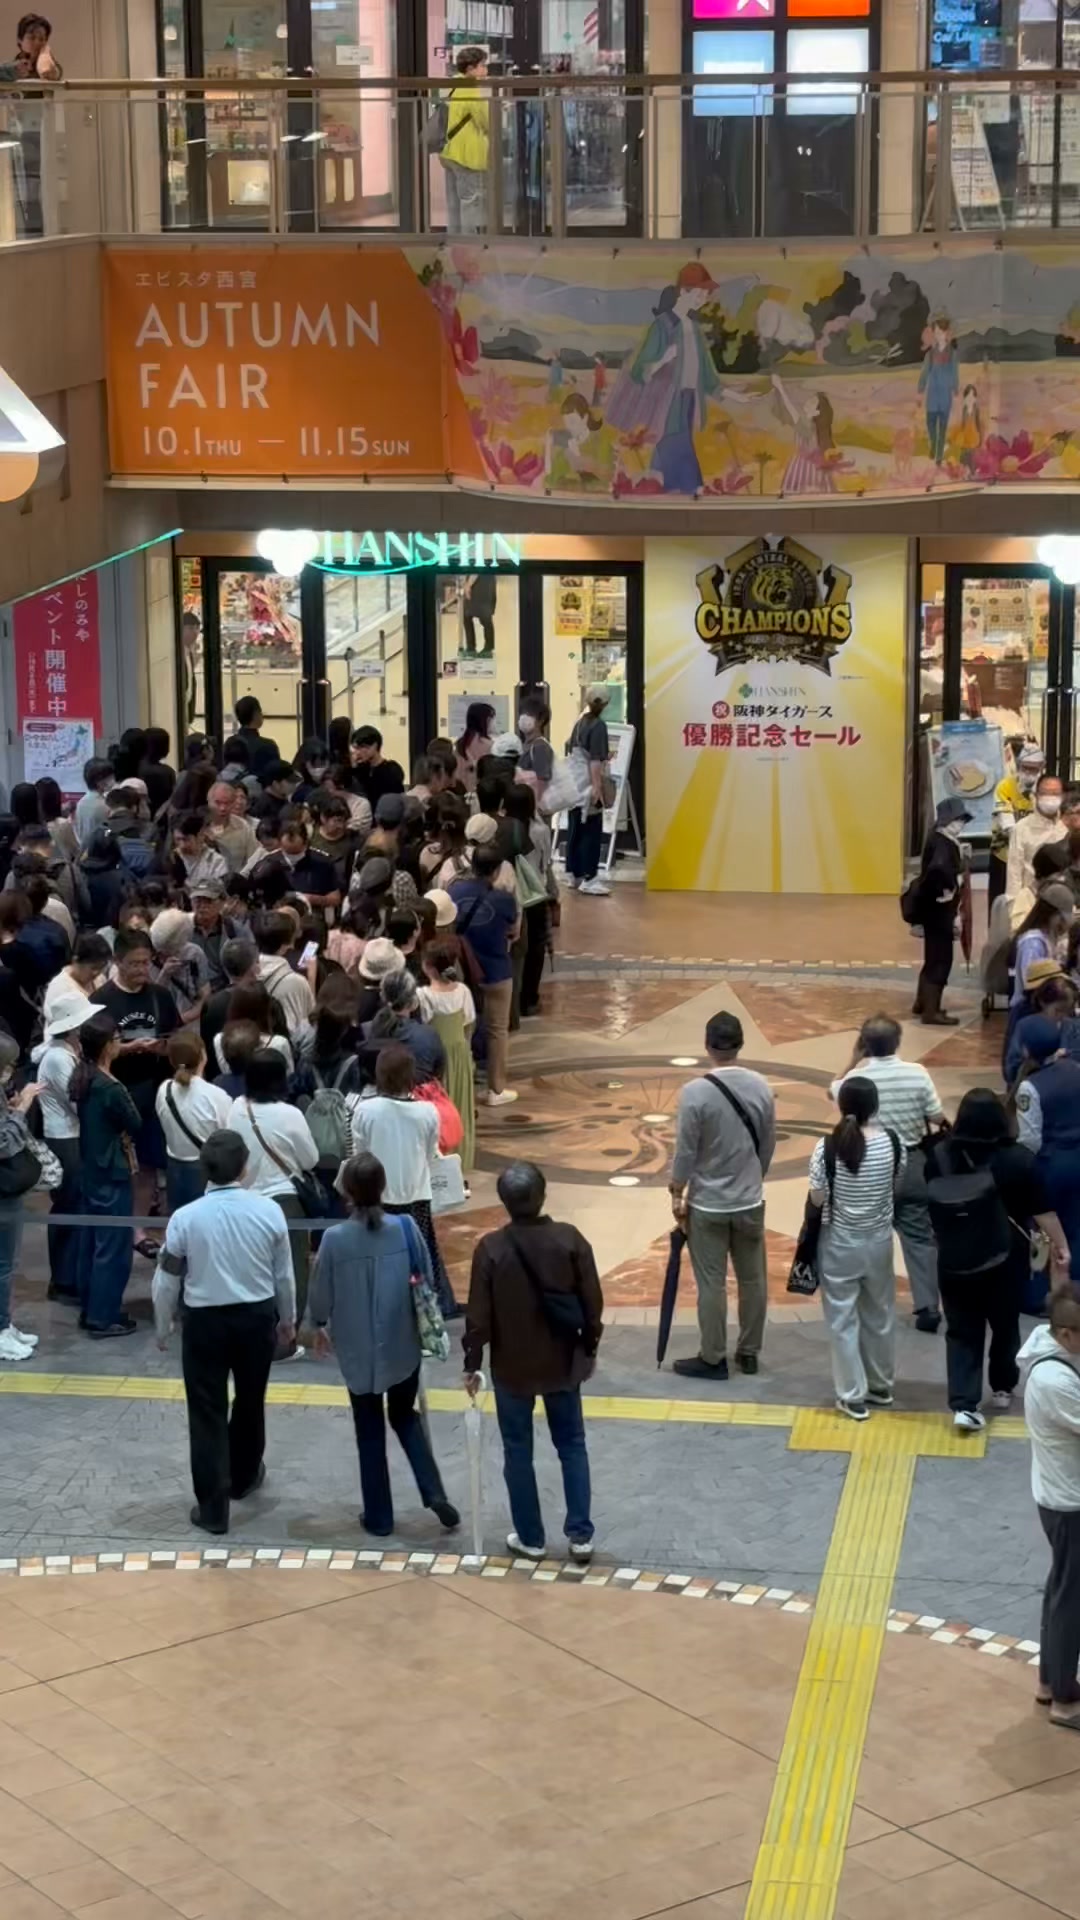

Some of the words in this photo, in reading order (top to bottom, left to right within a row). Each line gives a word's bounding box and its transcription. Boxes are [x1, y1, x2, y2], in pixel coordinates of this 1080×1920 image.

[135, 271, 257, 289] エビスタ西宮
[135, 301, 381, 348] AUTUMN
[140, 363, 270, 409] FAIR
[322, 530, 521, 568] HANSHIN
[696, 602, 852, 641] CHAMPIONS
[753, 685, 807, 698] HANSHIN
[733, 704, 834, 718] 阪神タイガース
[683, 723, 861, 747] 優勝記念セール
